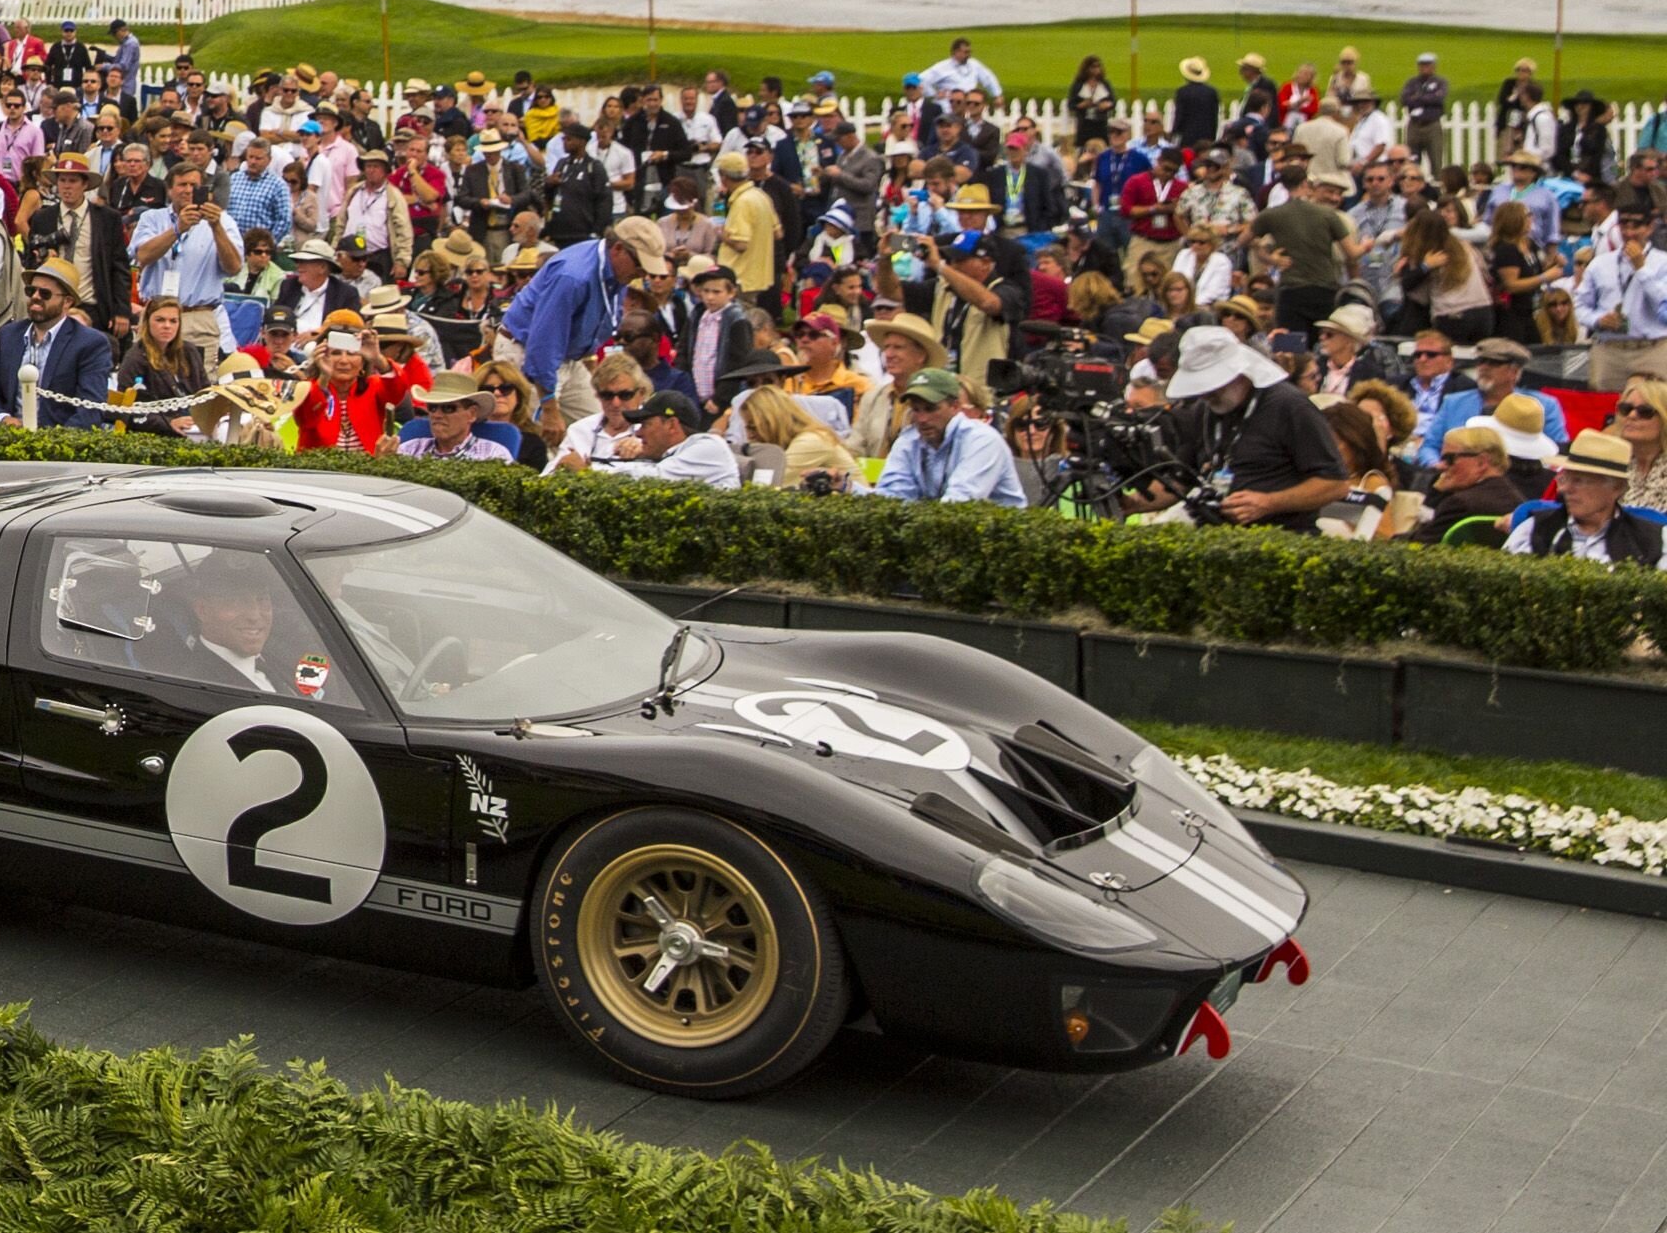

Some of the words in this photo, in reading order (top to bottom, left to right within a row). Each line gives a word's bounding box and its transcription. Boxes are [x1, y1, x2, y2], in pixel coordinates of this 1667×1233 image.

[755, 697, 948, 757] 2
[226, 724, 332, 905] 2
[469, 791, 509, 819] NZ
[397, 887, 492, 922] FORD
[548, 872, 606, 1042] Firestone
